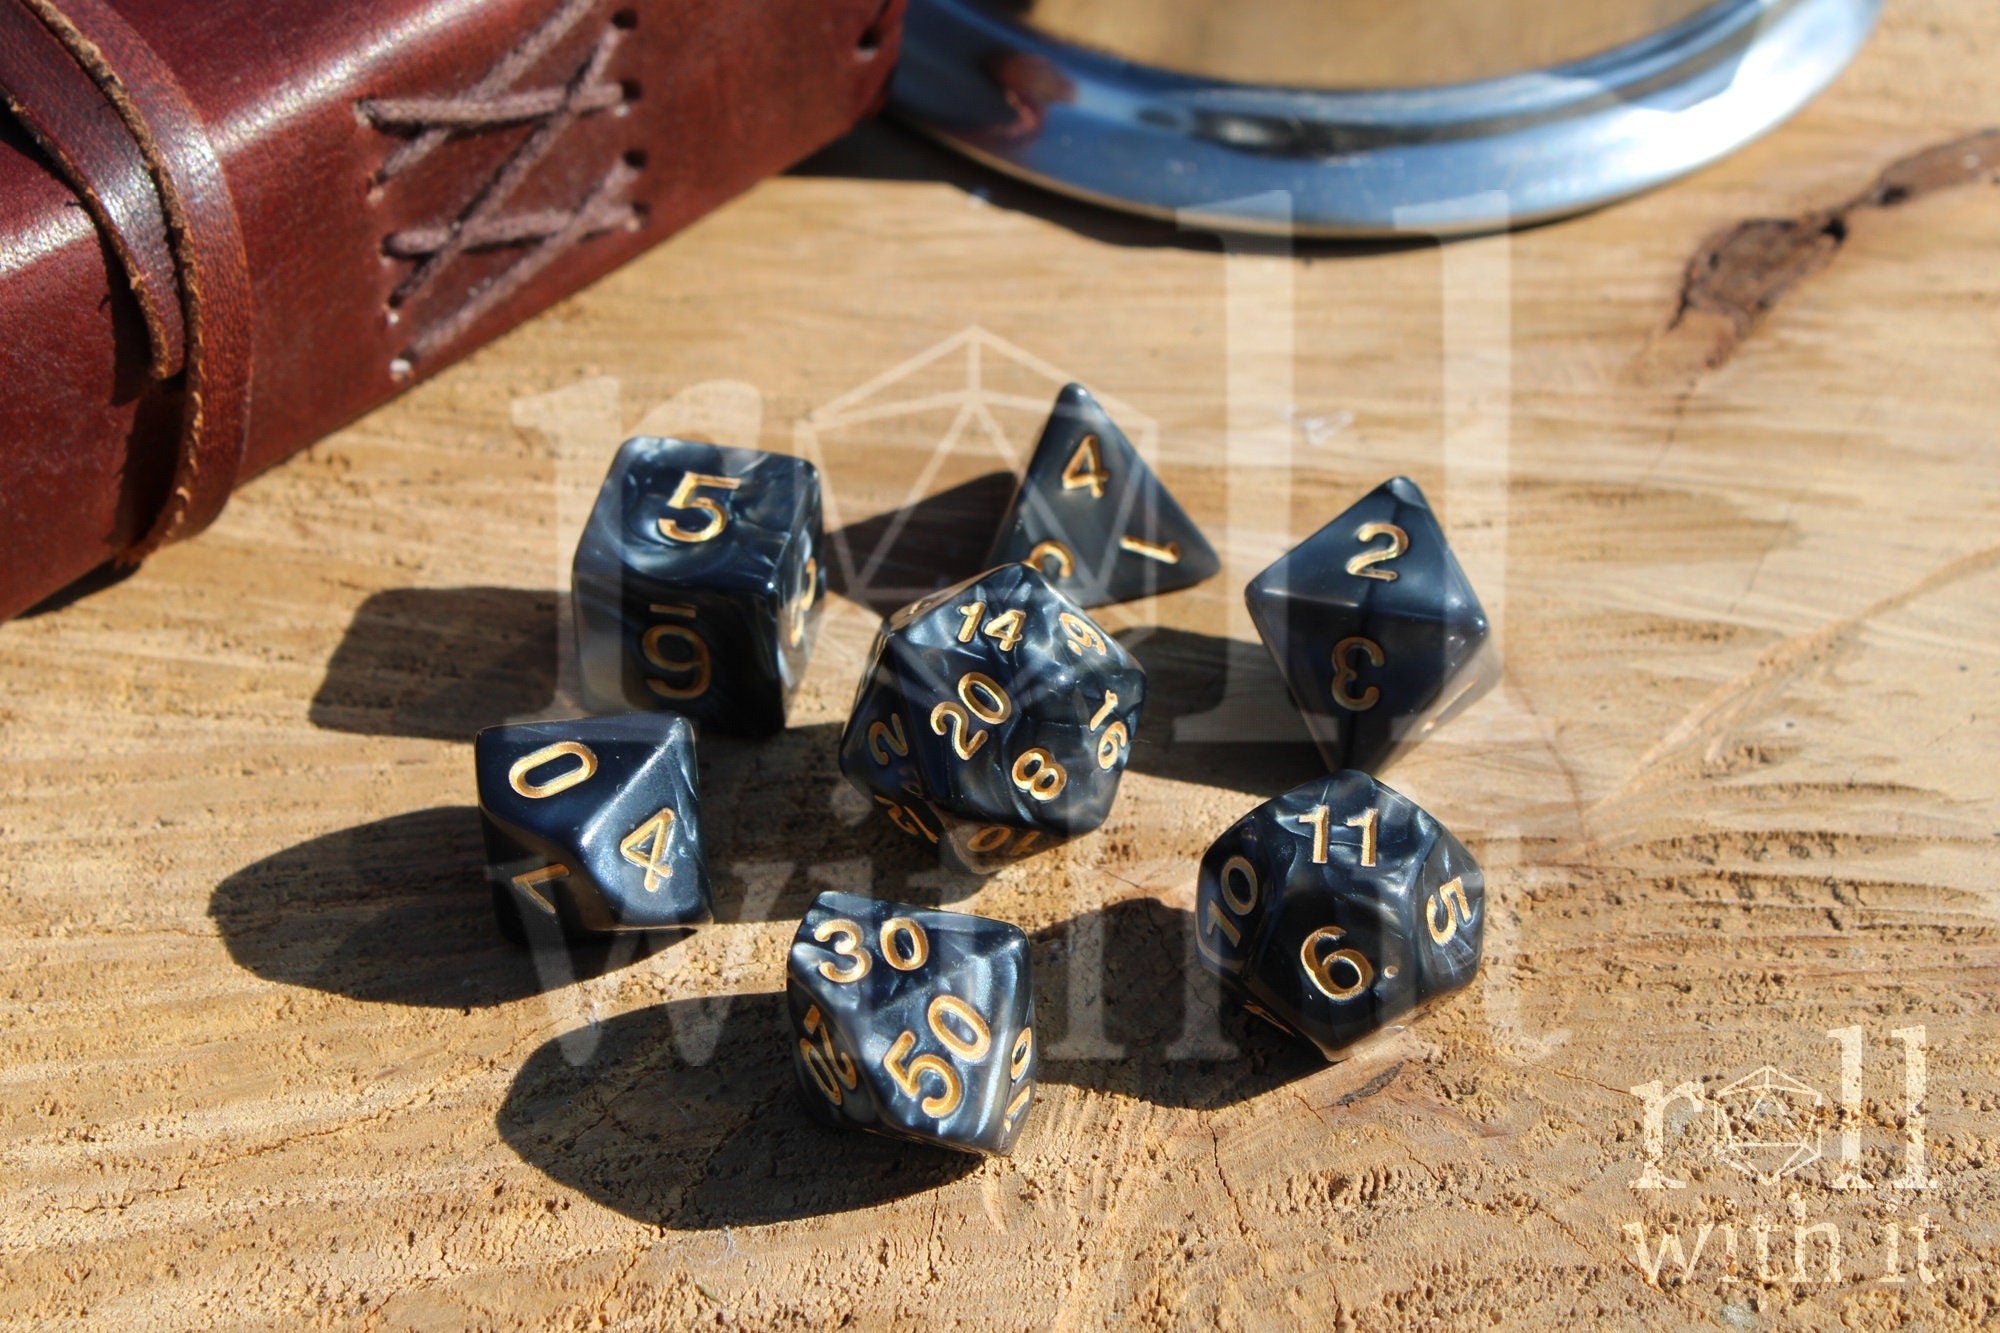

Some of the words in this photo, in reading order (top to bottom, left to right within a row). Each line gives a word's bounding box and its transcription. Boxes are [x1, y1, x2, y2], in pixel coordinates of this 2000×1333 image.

[1062, 434, 1109, 498] 4
[657, 471, 740, 543] 5
[1120, 535, 1180, 564] 1
[1346, 522, 1409, 581] 2
[957, 601, 1027, 651] 14
[1331, 636, 1385, 711] 3
[868, 713, 908, 766] 2
[930, 672, 1011, 760] 20
[1089, 689, 1128, 770] 16
[508, 741, 598, 799] 0
[1012, 747, 1067, 801] 8
[620, 807, 676, 892] 4
[1299, 803, 1379, 867] 11
[1206, 855, 1258, 948] 10
[1426, 876, 1472, 946] 5
[814, 917, 930, 983] 30
[800, 1004, 857, 1105] 20
[883, 995, 992, 1118] 50
